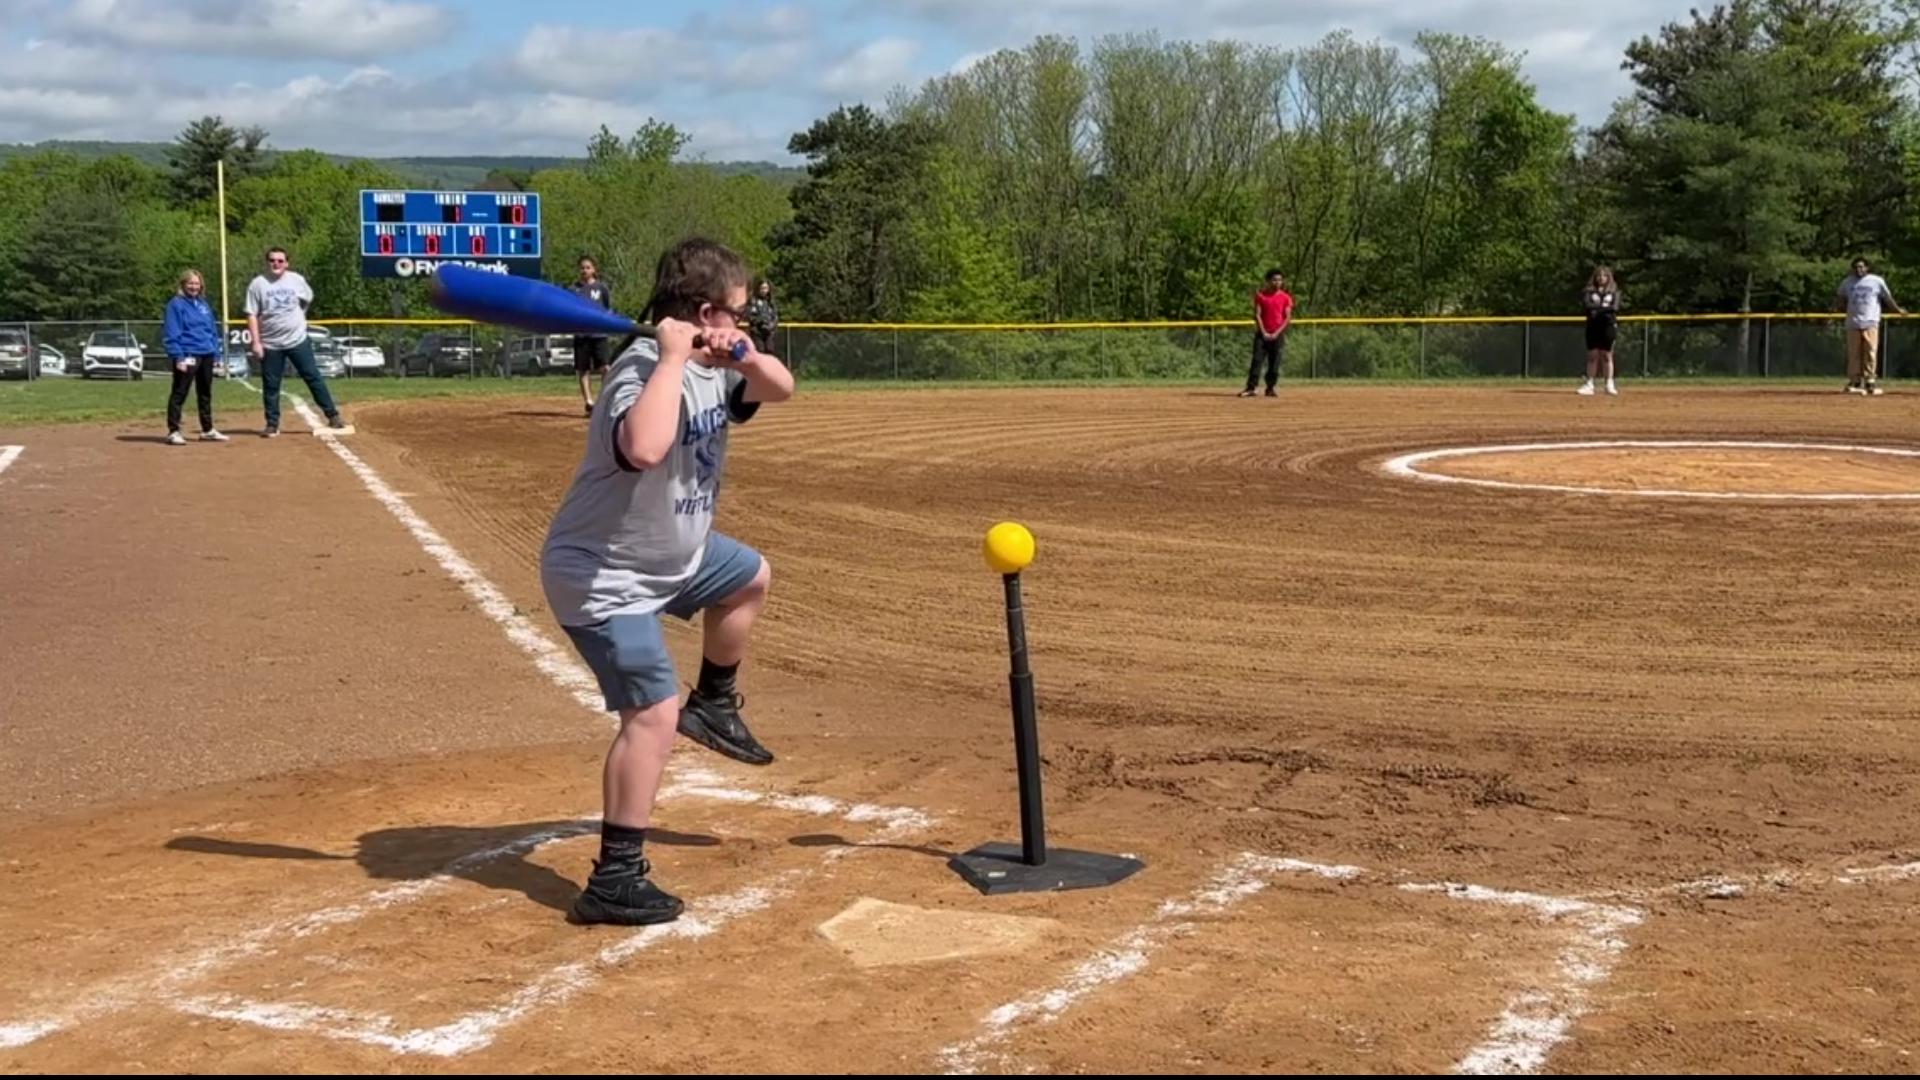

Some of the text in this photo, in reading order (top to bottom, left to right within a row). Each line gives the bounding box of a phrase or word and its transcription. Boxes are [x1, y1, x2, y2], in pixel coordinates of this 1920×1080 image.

[512, 205, 525, 225] 0
[380, 235, 392, 255] 0
[426, 235, 439, 255] 0
[472, 236, 484, 256] 0
